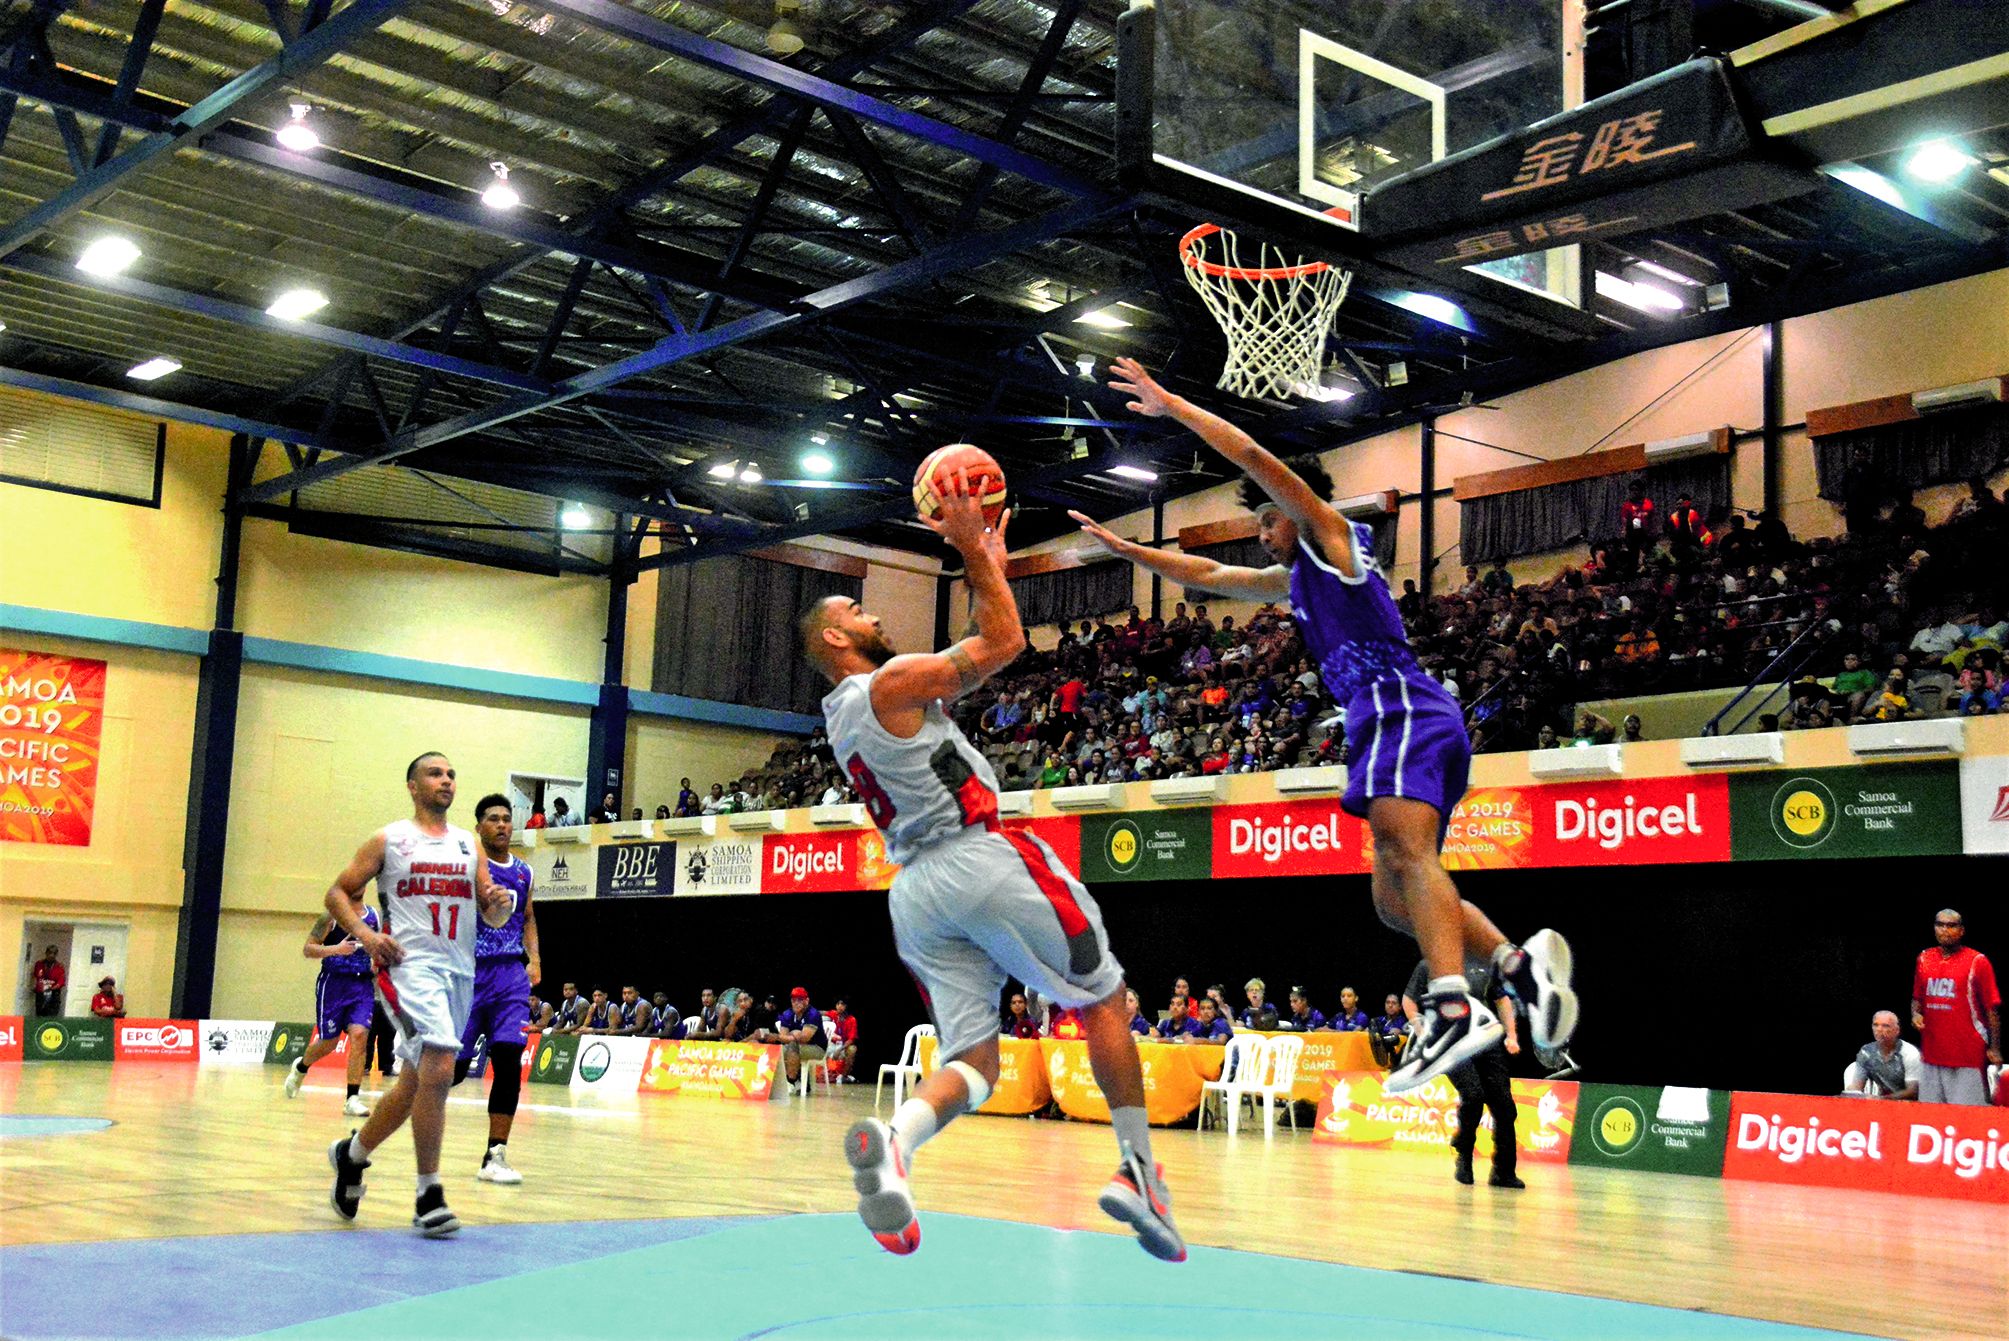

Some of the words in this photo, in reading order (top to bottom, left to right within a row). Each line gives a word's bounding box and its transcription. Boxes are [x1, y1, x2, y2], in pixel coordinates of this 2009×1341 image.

[0, 676, 77, 704] MOA
[0, 764, 61, 788] MES
[1858, 790, 1896, 802] Samoa
[1470, 802, 1513, 817] 2019
[1786, 806, 1820, 820] SCB
[1844, 802, 1913, 816] Commercial
[1555, 793, 1702, 849] Digicel
[1864, 816, 1894, 829] Bank
[1154, 829, 1177, 838] Samoa
[1467, 821, 1521, 837] GAMES
[1146, 838, 1186, 849] Commercial
[1230, 813, 1341, 861] Digicel
[712, 844, 752, 855] SAMOA
[1114, 840, 1133, 851] SCB
[711, 855, 752, 864] SHIPPING
[1157, 849, 1175, 860] Bank
[613, 845, 660, 879] BBE
[773, 843, 844, 881] Digicel
[551, 868, 569, 879] NEH
[711, 874, 752, 884] LIMITED
[427, 902, 459, 940] 11
[127, 1031, 153, 1041] EPC
[679, 1046, 713, 1060] SAMOA
[716, 1047, 744, 1062] 2019
[1304, 1044, 1333, 1056] 2019
[669, 1063, 707, 1078] PACIFIC
[709, 1064, 745, 1080] GAMES
[1302, 1059, 1335, 1070] GAMES
[1366, 1104, 1440, 1125] PACIFIC
[1605, 1120, 1631, 1133] SCB
[1651, 1123, 1706, 1137] Commercial
[1665, 1136, 1688, 1148] Bank
[1736, 1113, 1882, 1162] Digicel
